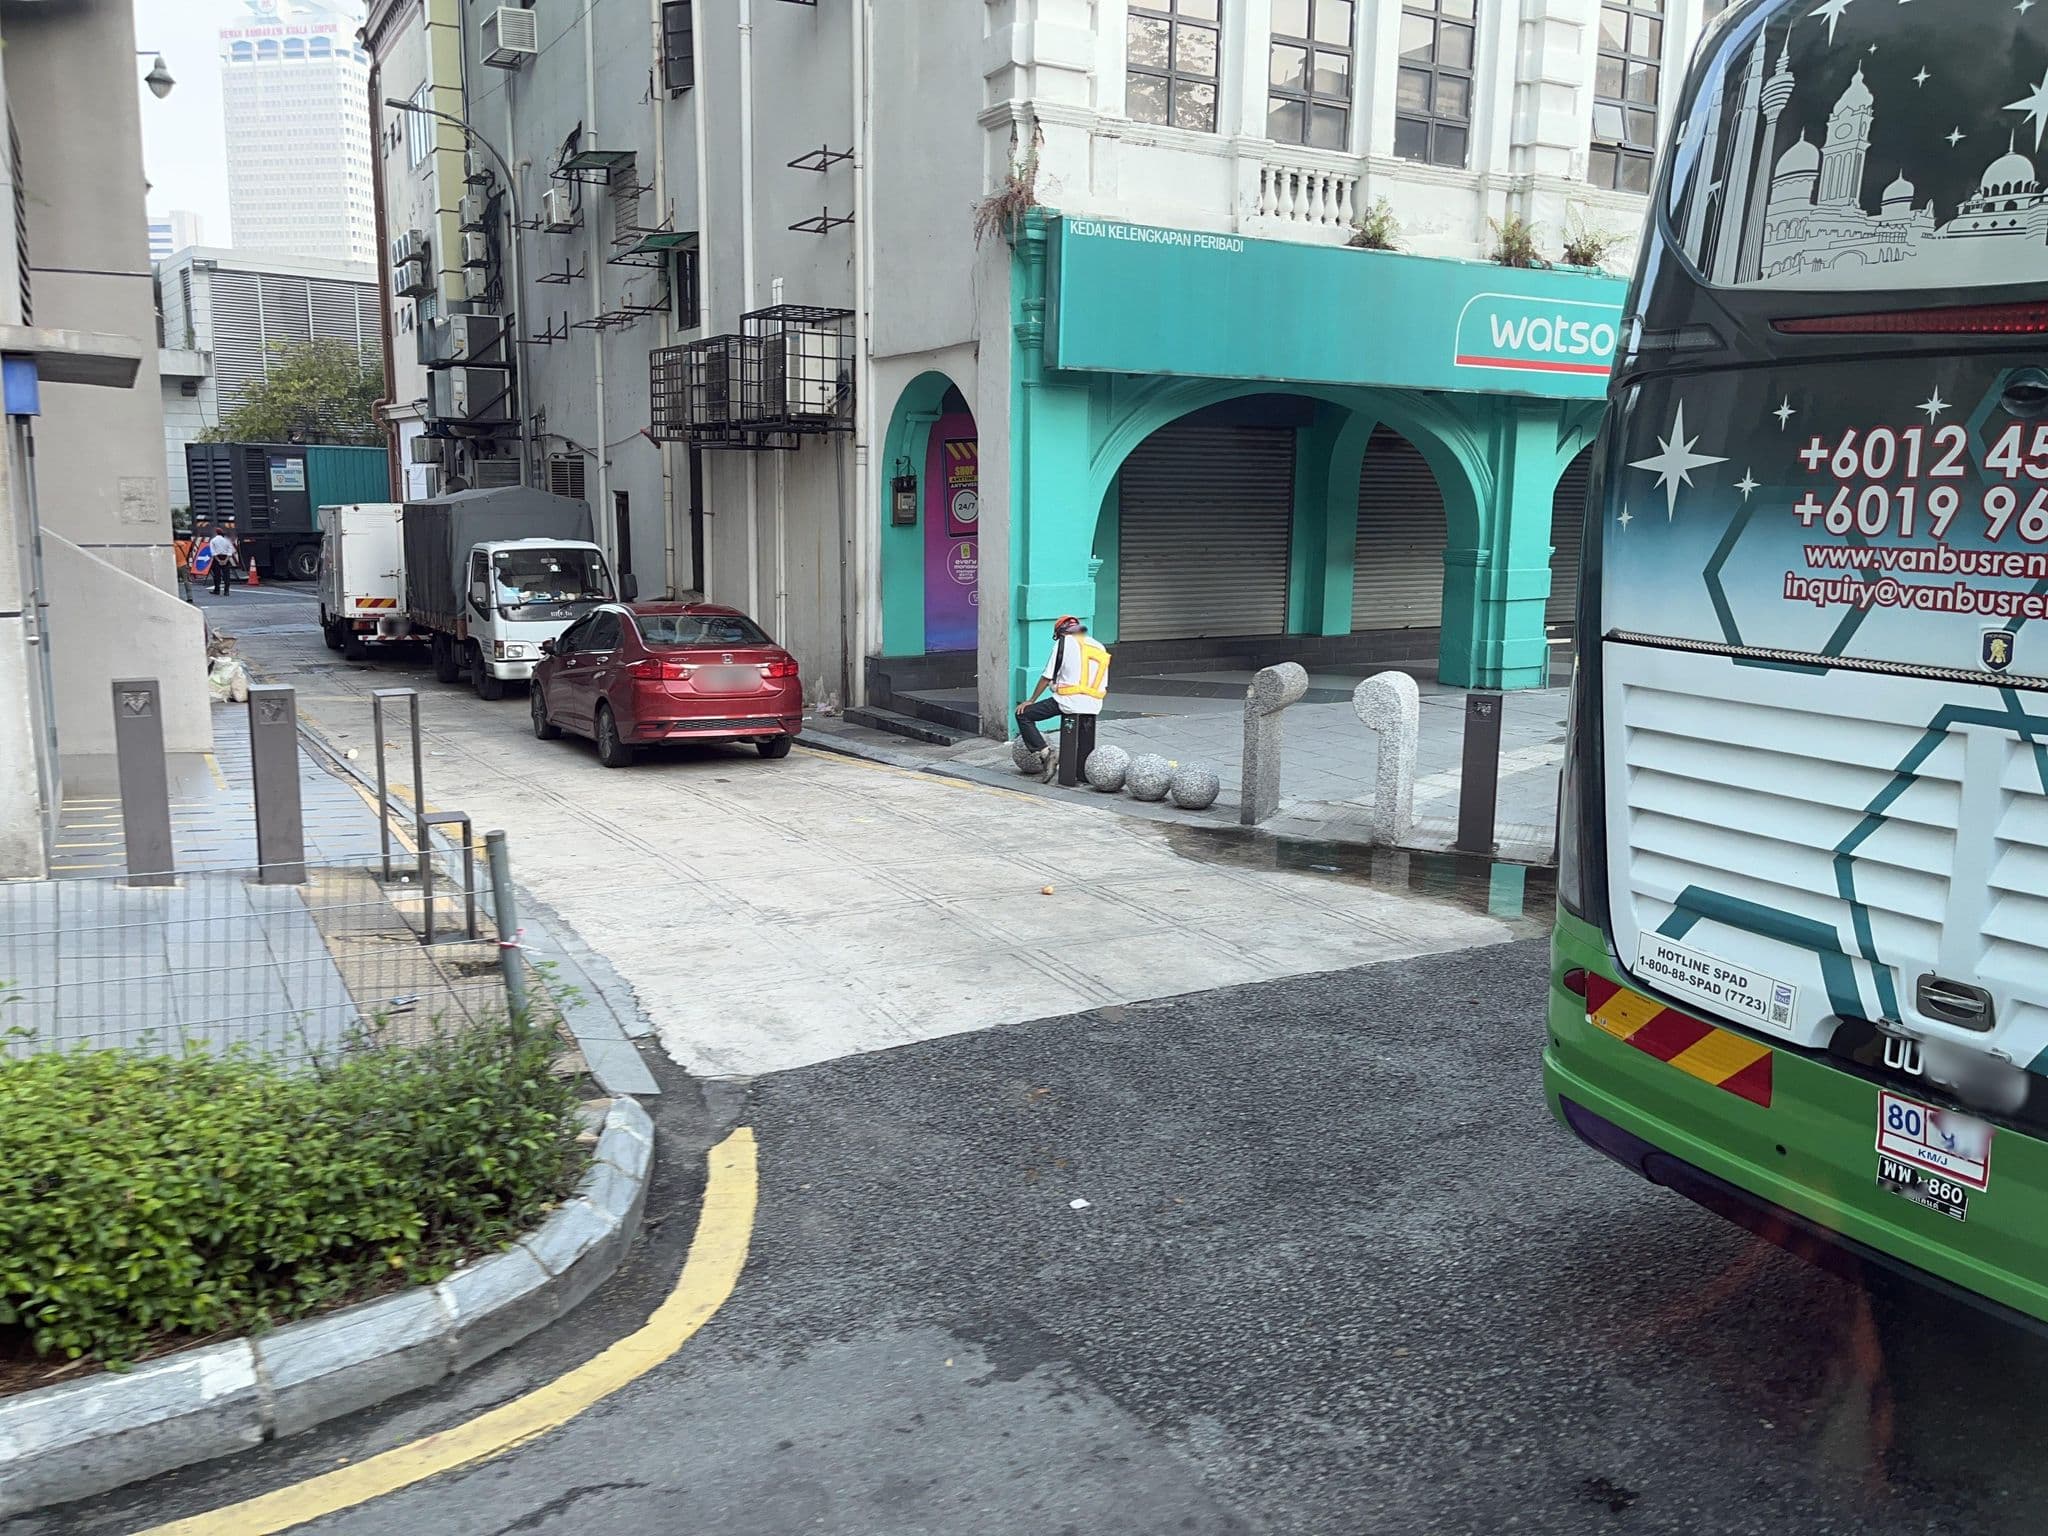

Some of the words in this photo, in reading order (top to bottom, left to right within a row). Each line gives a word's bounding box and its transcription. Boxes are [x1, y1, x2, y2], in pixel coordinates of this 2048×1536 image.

[1070, 220, 1106, 237] KEDAI
[1108, 225, 1191, 247] KELENGKAPAN
[1194, 234, 1244, 253] PERIBADI
[1490, 313, 1615, 356] watso
[954, 465, 976, 476] SHOP
[1799, 424, 1968, 480] +6012
[1985, 424, 2048, 480] 45
[958, 502, 975, 511] 24/7
[1793, 484, 1960, 538] +6019
[1983, 485, 2048, 543] 96
[1639, 955, 1722, 995] 1-800-88-SPAD
[1725, 988, 1767, 1015] (7723)
[1657, 946, 1711, 976] HOTLINE
[1713, 967, 1748, 988] SPAD
[1888, 1103, 1921, 1136] 80
[1917, 1148, 1948, 1166] KM/J
